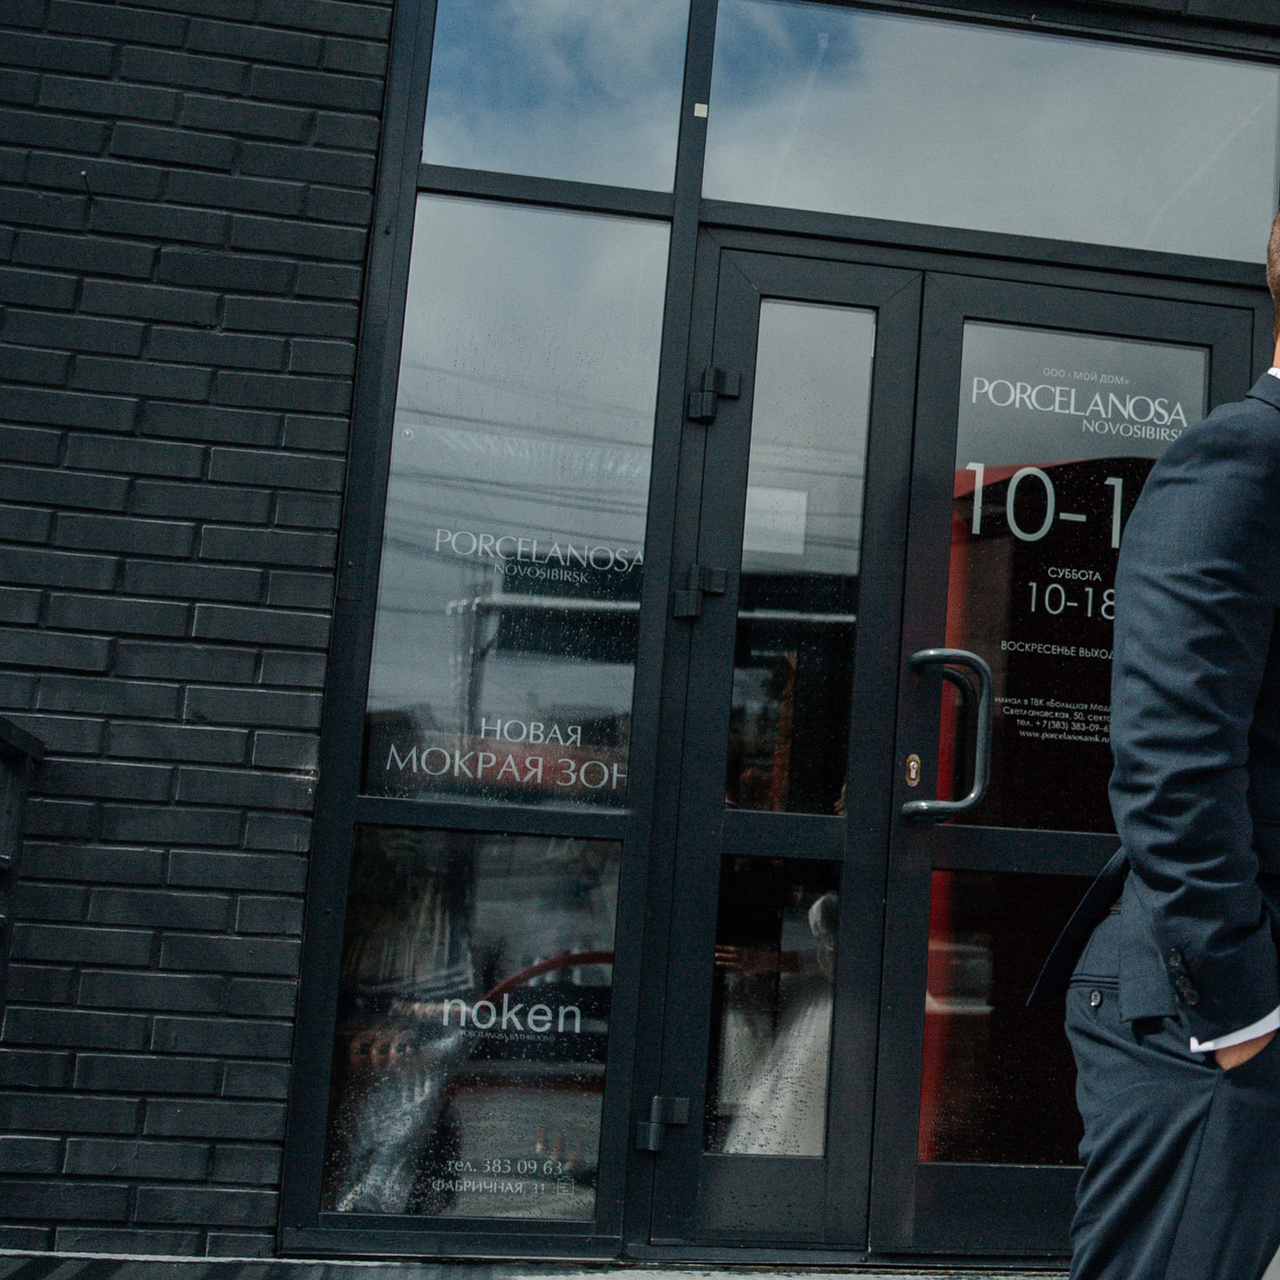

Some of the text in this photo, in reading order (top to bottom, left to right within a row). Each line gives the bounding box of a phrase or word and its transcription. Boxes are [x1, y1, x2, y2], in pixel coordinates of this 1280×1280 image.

[1043, 367, 1066, 378] ООО
[971, 376, 1188, 427] PORCELANOSA
[1082, 419, 1183, 442] NOVOSIBIRS
[965, 462, 1123, 549] 10-1
[434, 528, 644, 573] PORCELANOSA
[494, 563, 589, 584] NOVOSIBIRSK
[1047, 567, 1102, 582] СУББОТА
[1028, 582, 1115, 620] 10-18
[1001, 640, 1076, 656] ВОСКРЕСЕНЬЕ
[480, 717, 582, 747] НОВАЯ
[1071, 721, 1111, 733] 383-09-6
[386, 743, 543, 784] МОКРАЯ
[442, 992, 581, 1033] noken
[446, 1158, 563, 1175] тел. 383 09 63
[432, 1179, 527, 1195] ФАБРИЧНАЯ,
